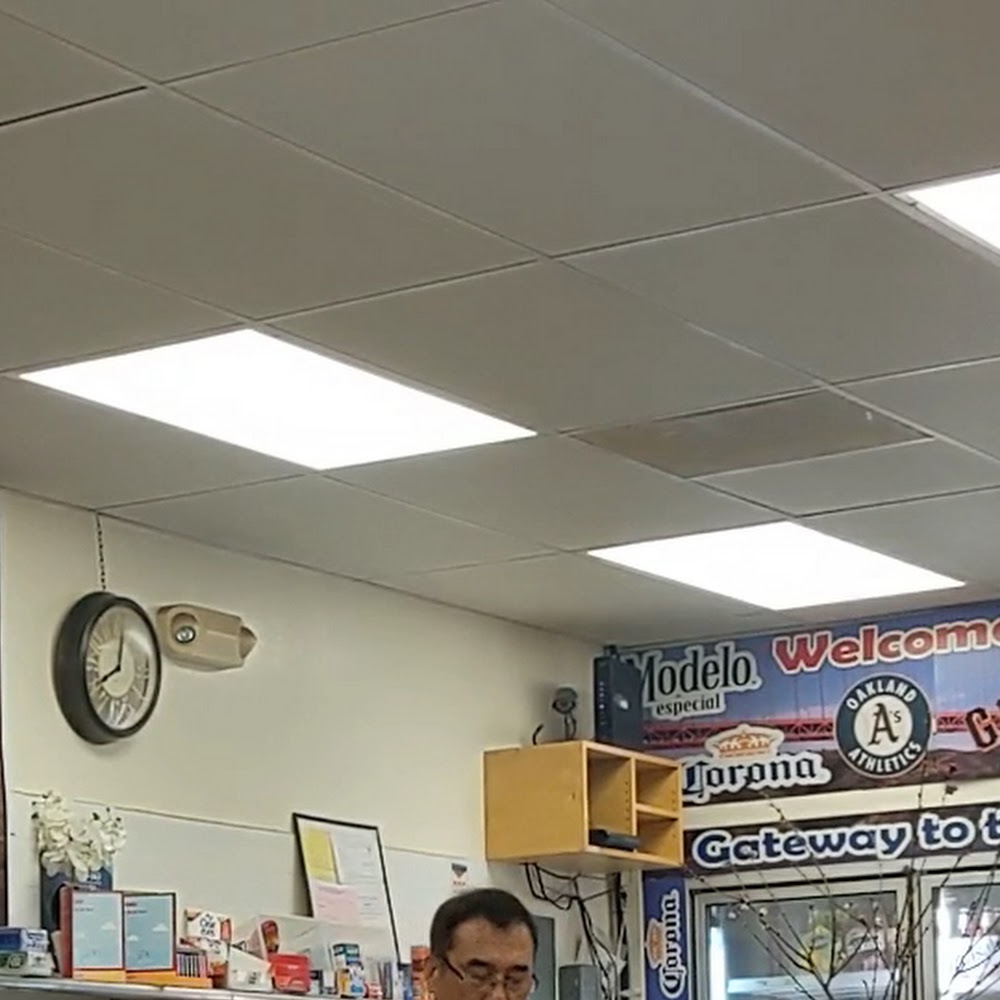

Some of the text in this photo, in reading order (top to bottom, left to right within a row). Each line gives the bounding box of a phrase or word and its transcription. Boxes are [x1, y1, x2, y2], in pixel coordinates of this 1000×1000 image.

[655, 693, 721, 717] especial
[846, 679, 918, 711] OAKLAND
[848, 739, 923, 773] ATHLETICS
[682, 755, 819, 799] Corona
[697, 825, 908, 866] Gateway
[921, 817, 970, 846] to
[661, 891, 686, 998] Corona
